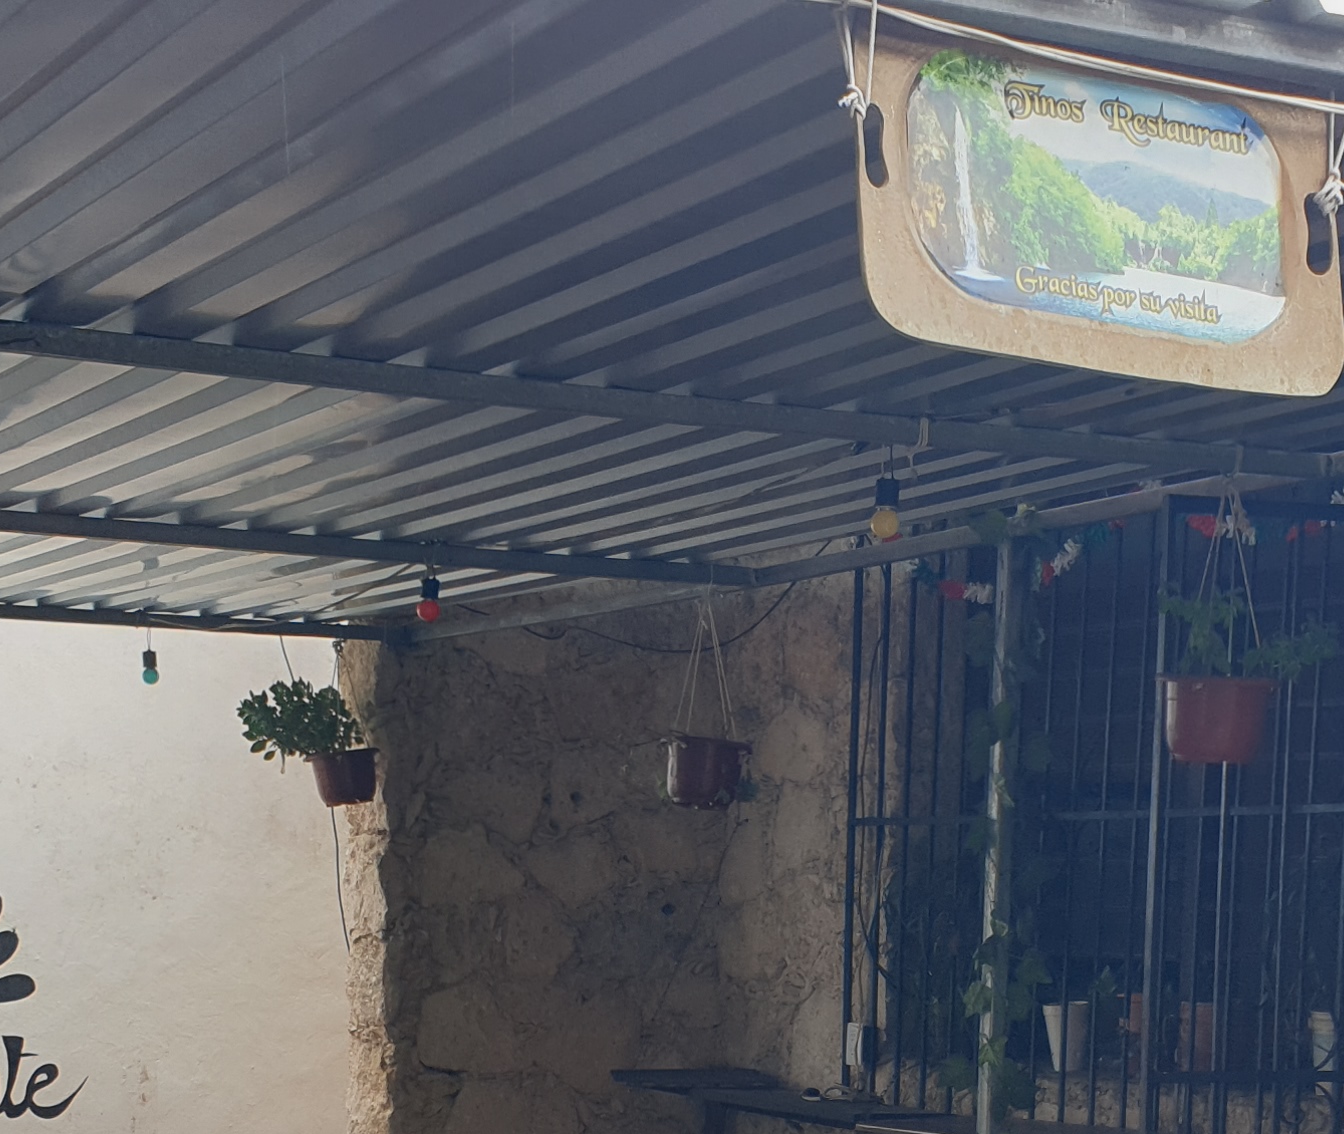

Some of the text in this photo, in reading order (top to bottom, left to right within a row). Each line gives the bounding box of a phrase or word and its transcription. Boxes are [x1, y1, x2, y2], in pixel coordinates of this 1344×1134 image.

[1004, 80, 1253, 155] Tinos Restaurant
[1015, 266, 1223, 325] Gracias por su visita
